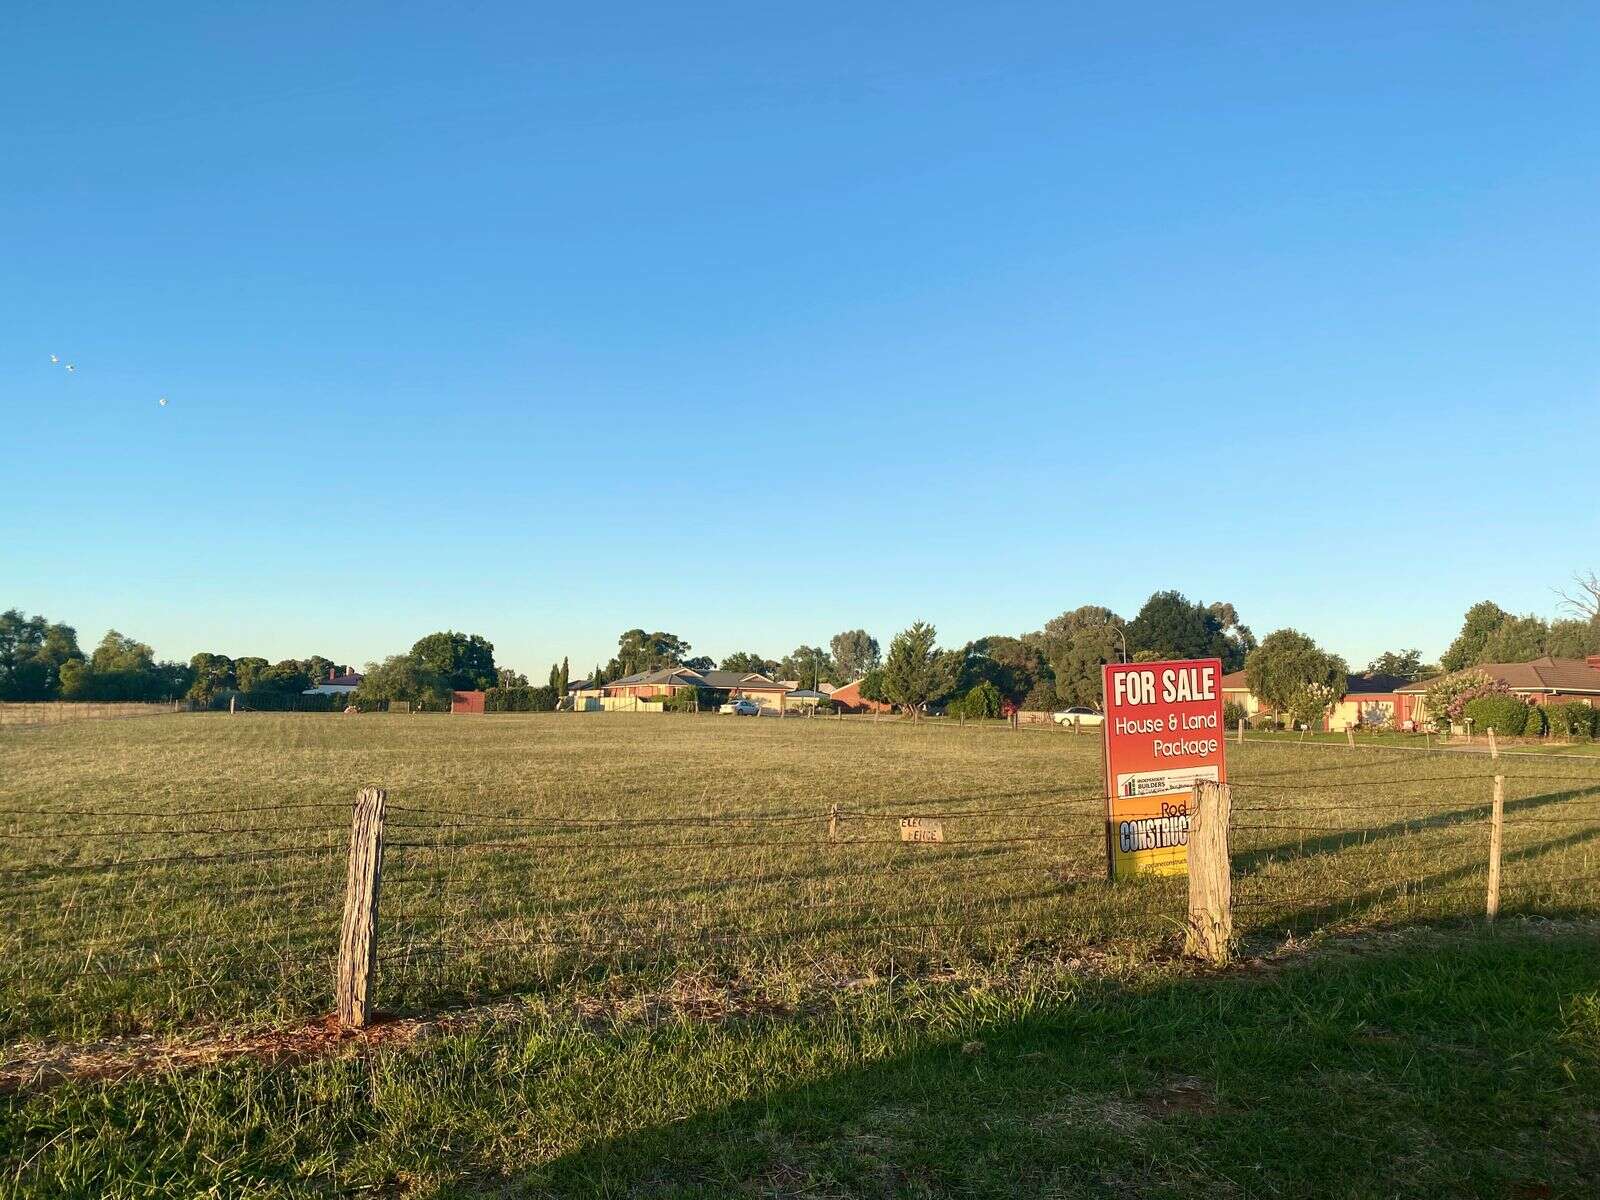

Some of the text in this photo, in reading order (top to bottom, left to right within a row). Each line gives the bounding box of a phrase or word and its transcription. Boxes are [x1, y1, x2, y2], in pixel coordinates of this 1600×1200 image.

[1114, 667, 1215, 706] FOR SALE
[1115, 711, 1217, 735] House & Land
[1153, 738, 1218, 758] Package
[1161, 800, 1187, 817] Rod
